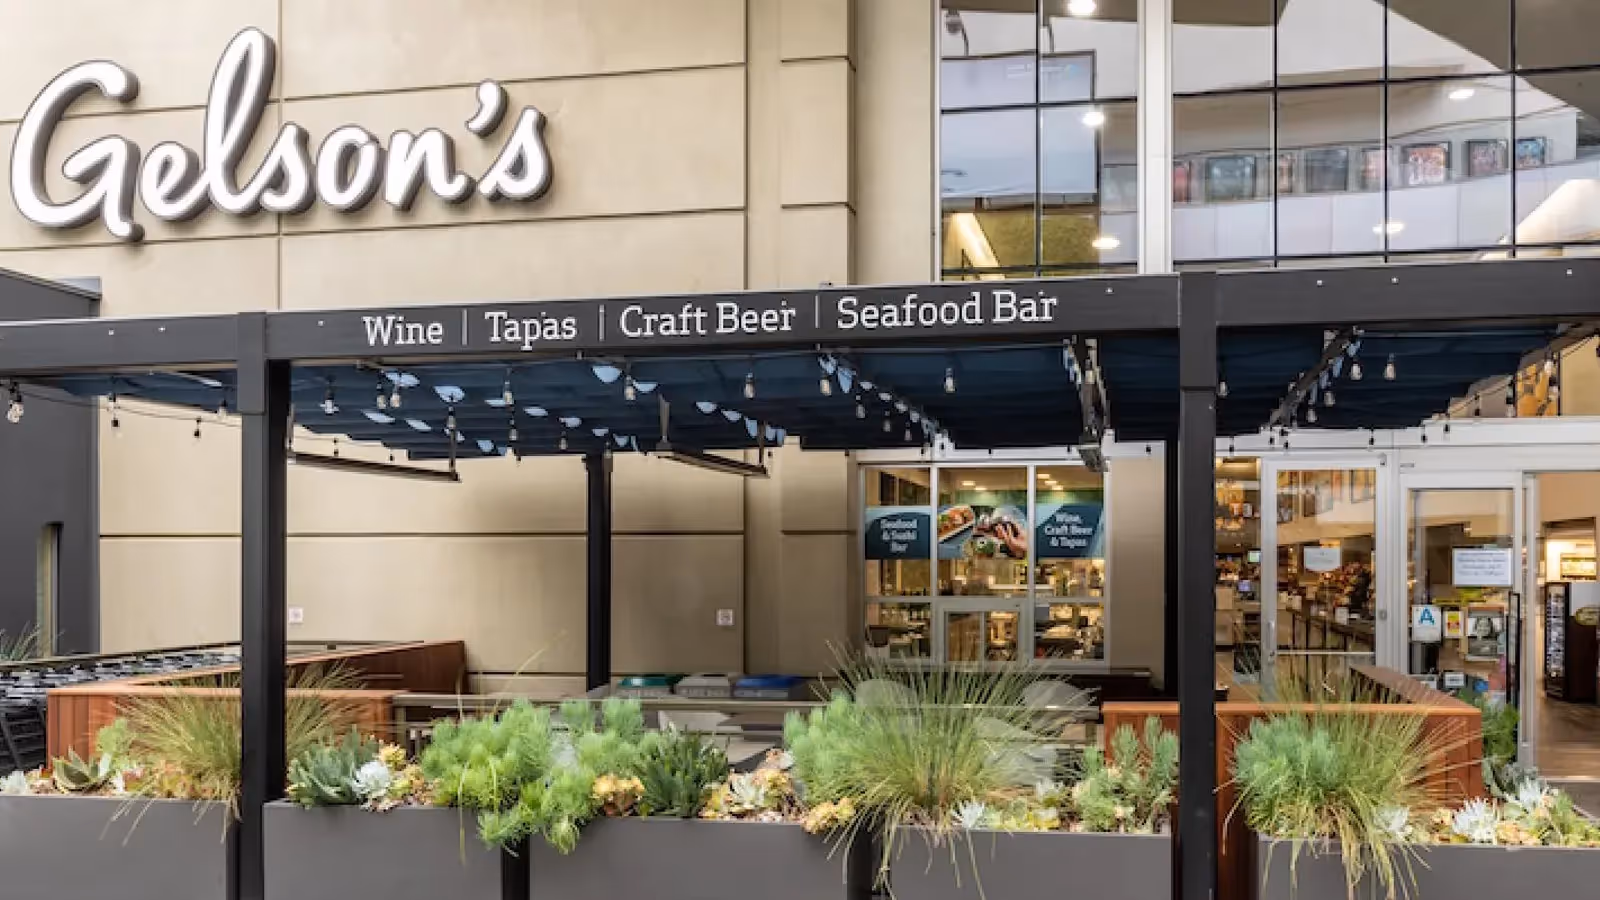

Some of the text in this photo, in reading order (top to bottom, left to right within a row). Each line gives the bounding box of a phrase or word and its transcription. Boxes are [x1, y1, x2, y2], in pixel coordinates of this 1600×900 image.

[9, 26, 554, 243] Gelson's
[362, 290, 1058, 350] Wine Tapas Craft Beer Seafood Bar
[1419, 607, 1435, 625] A
